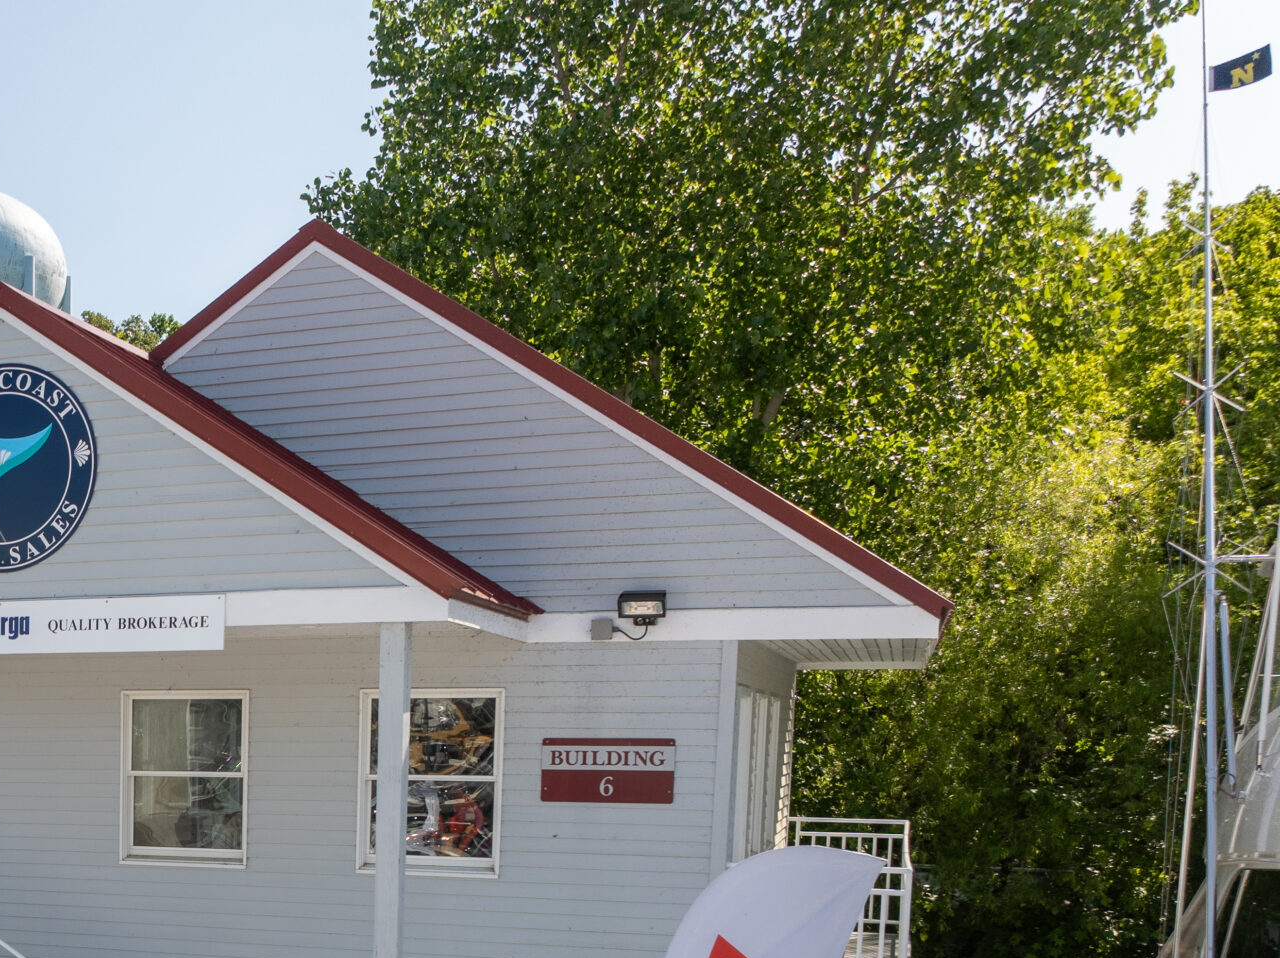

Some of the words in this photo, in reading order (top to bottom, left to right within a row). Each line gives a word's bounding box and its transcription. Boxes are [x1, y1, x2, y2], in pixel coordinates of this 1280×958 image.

[9, 500, 78, 565] SALES
[48, 617, 110, 635] QUALITY
[117, 615, 210, 630] BROKERAGE
[549, 750, 666, 766] BUILDING
[599, 776, 614, 797] 6
